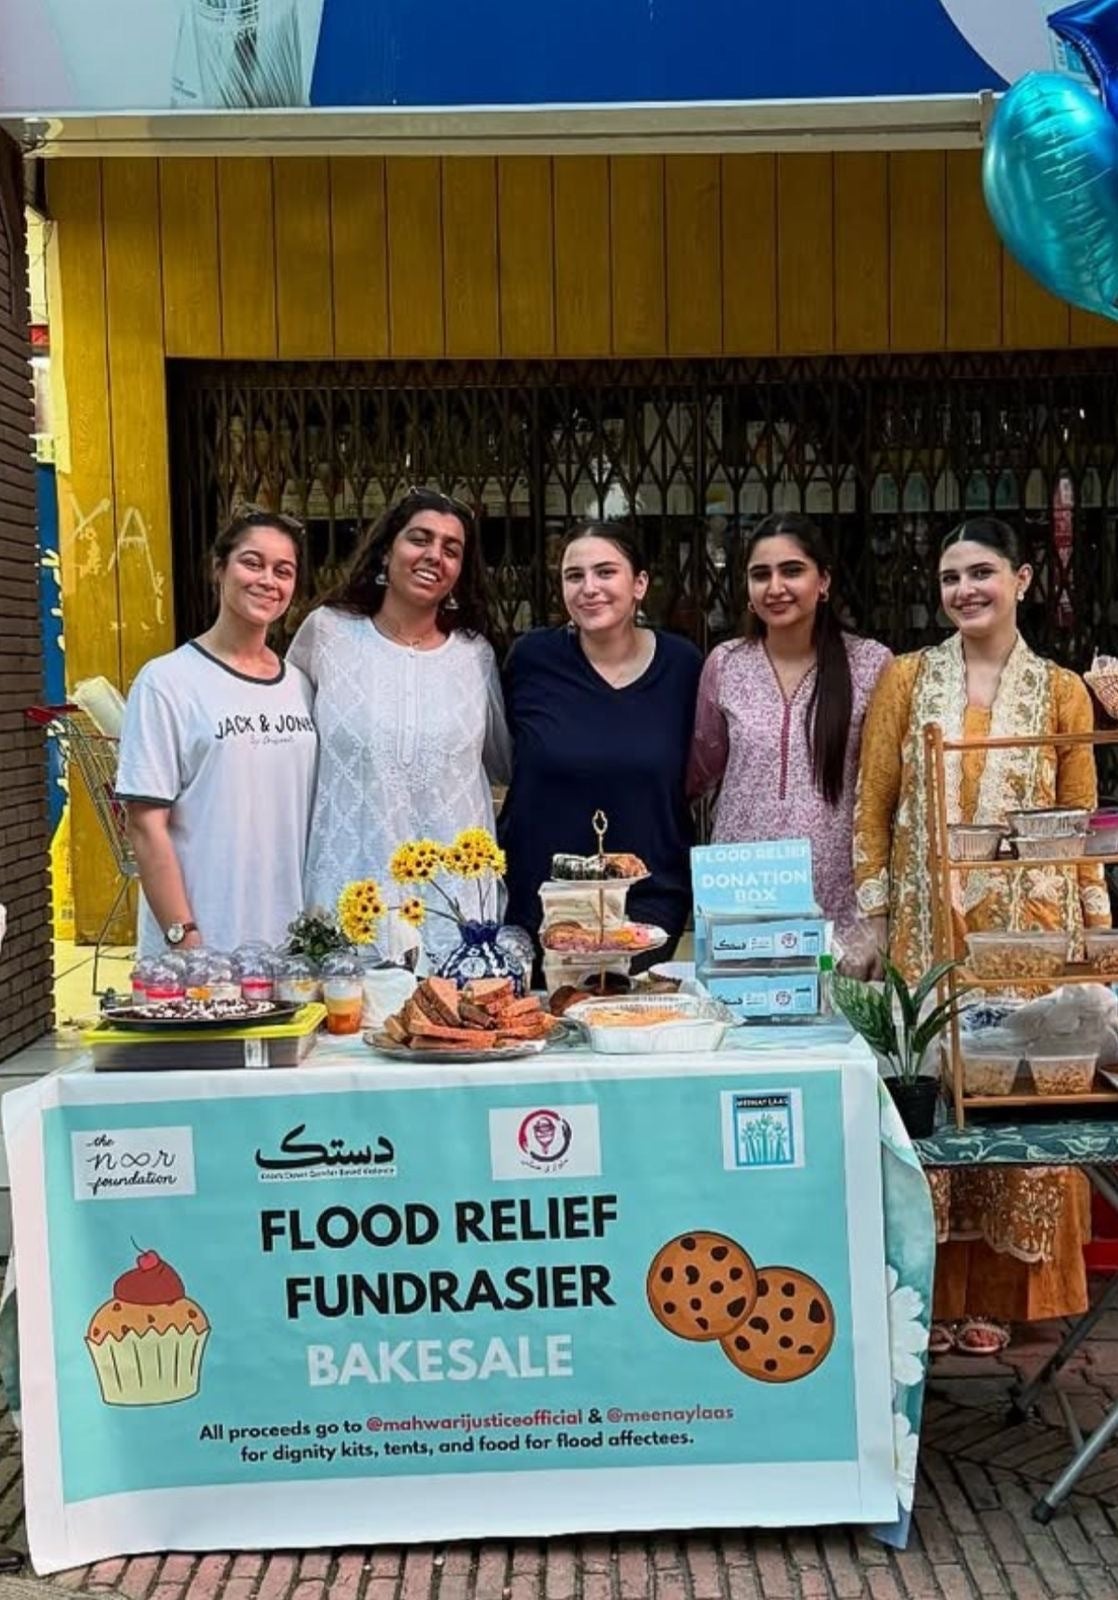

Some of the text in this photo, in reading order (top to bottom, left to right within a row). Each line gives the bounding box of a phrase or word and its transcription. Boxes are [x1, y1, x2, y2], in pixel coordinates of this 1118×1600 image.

[214, 714, 255, 740] JACK
[259, 713, 271, 733] &
[694, 843, 807, 864] FLOOD RELIEF
[702, 869, 808, 888] DONATION
[734, 887, 777, 903] BOX
[86, 1133, 115, 1148] the
[86, 1170, 178, 1197] foundation
[261, 1194, 617, 1252] FLOOD RELIEF
[286, 1264, 617, 1320] FUNDRASIER
[307, 1333, 574, 1387] BAKESALE
[199, 1403, 734, 1443] All proceeds go to @mahwarijusticeofficial & @meenaylaas
[240, 1429, 694, 1464] for dignity kits, tents, and food for flood affectees.
